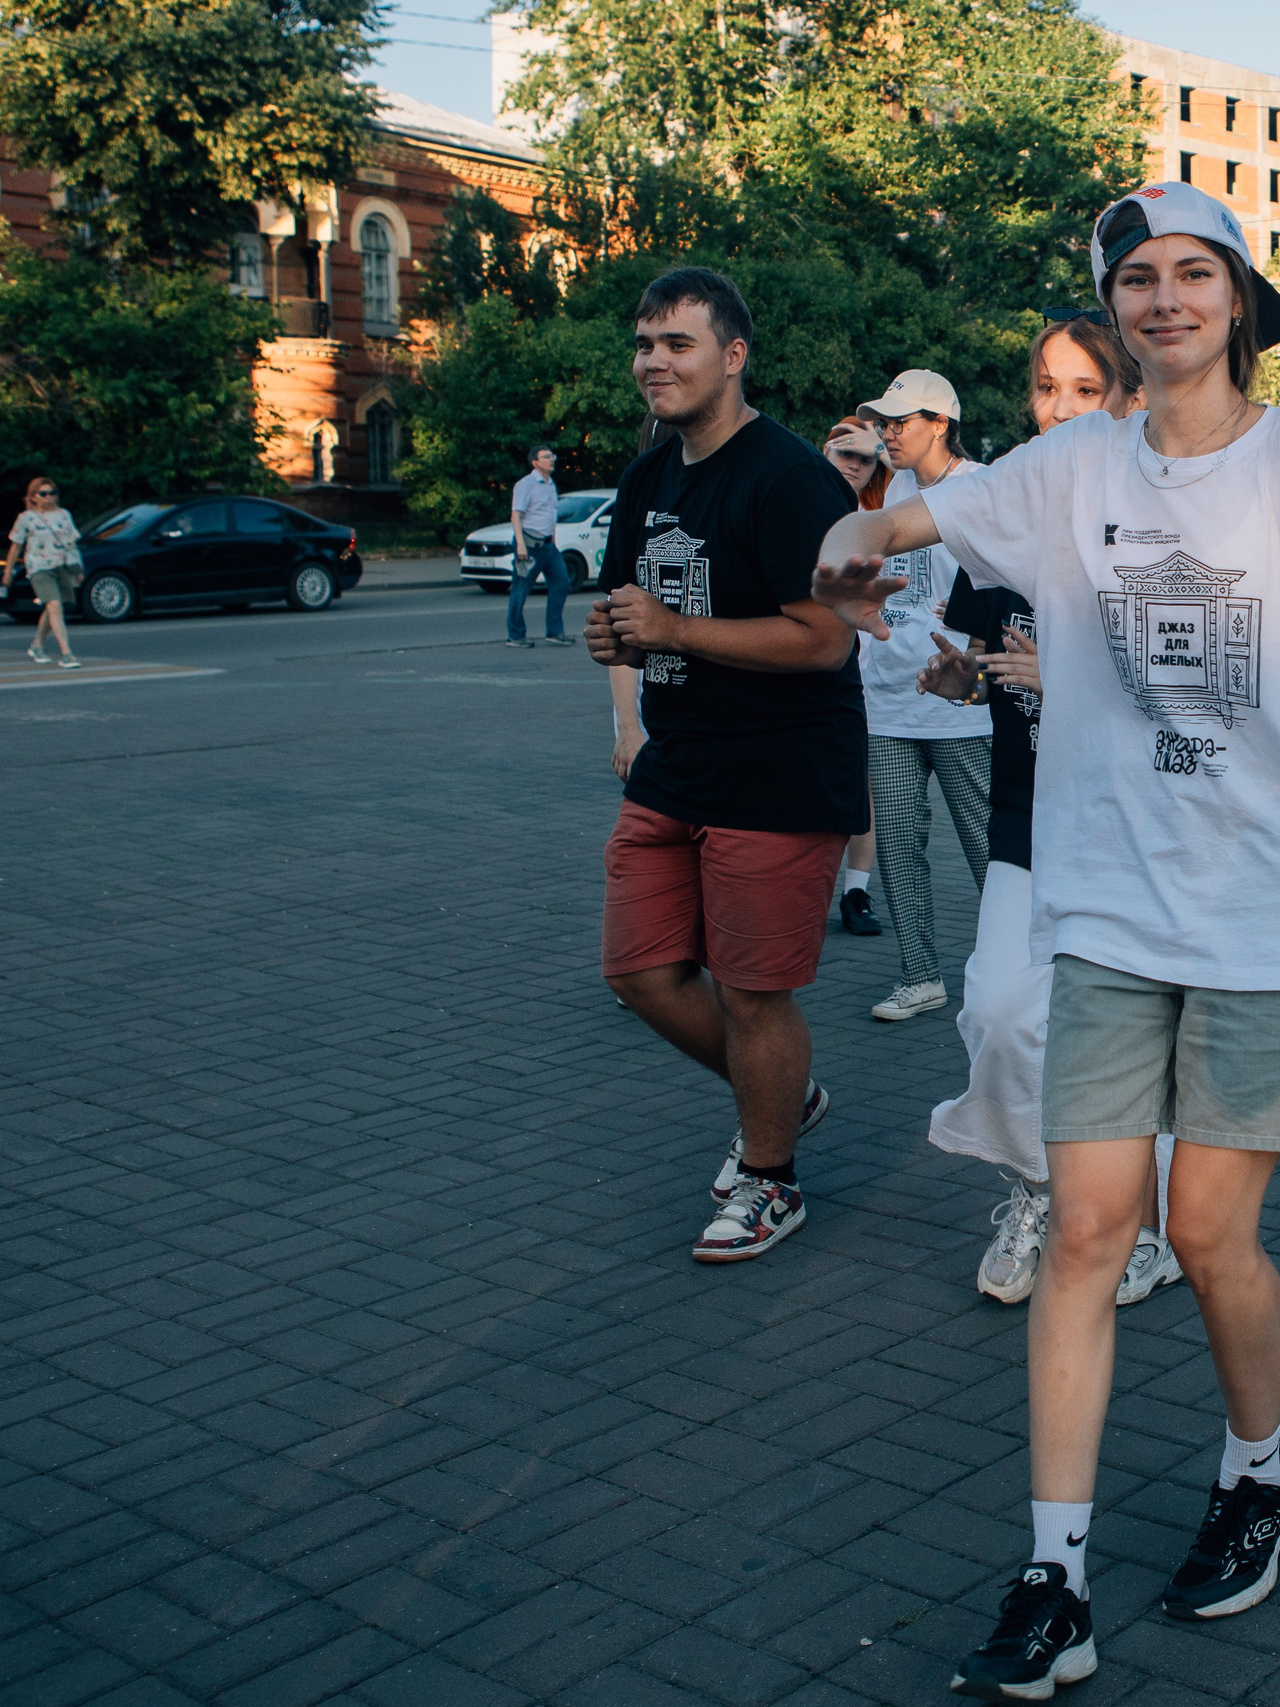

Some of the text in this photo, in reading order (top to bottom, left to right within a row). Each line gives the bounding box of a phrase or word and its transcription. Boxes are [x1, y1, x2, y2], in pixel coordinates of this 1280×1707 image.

[1158, 622, 1195, 635] ДЖАЗ
[1165, 638, 1189, 651] ДЛЯ
[1151, 654, 1203, 668] СМЕЛЫХ
